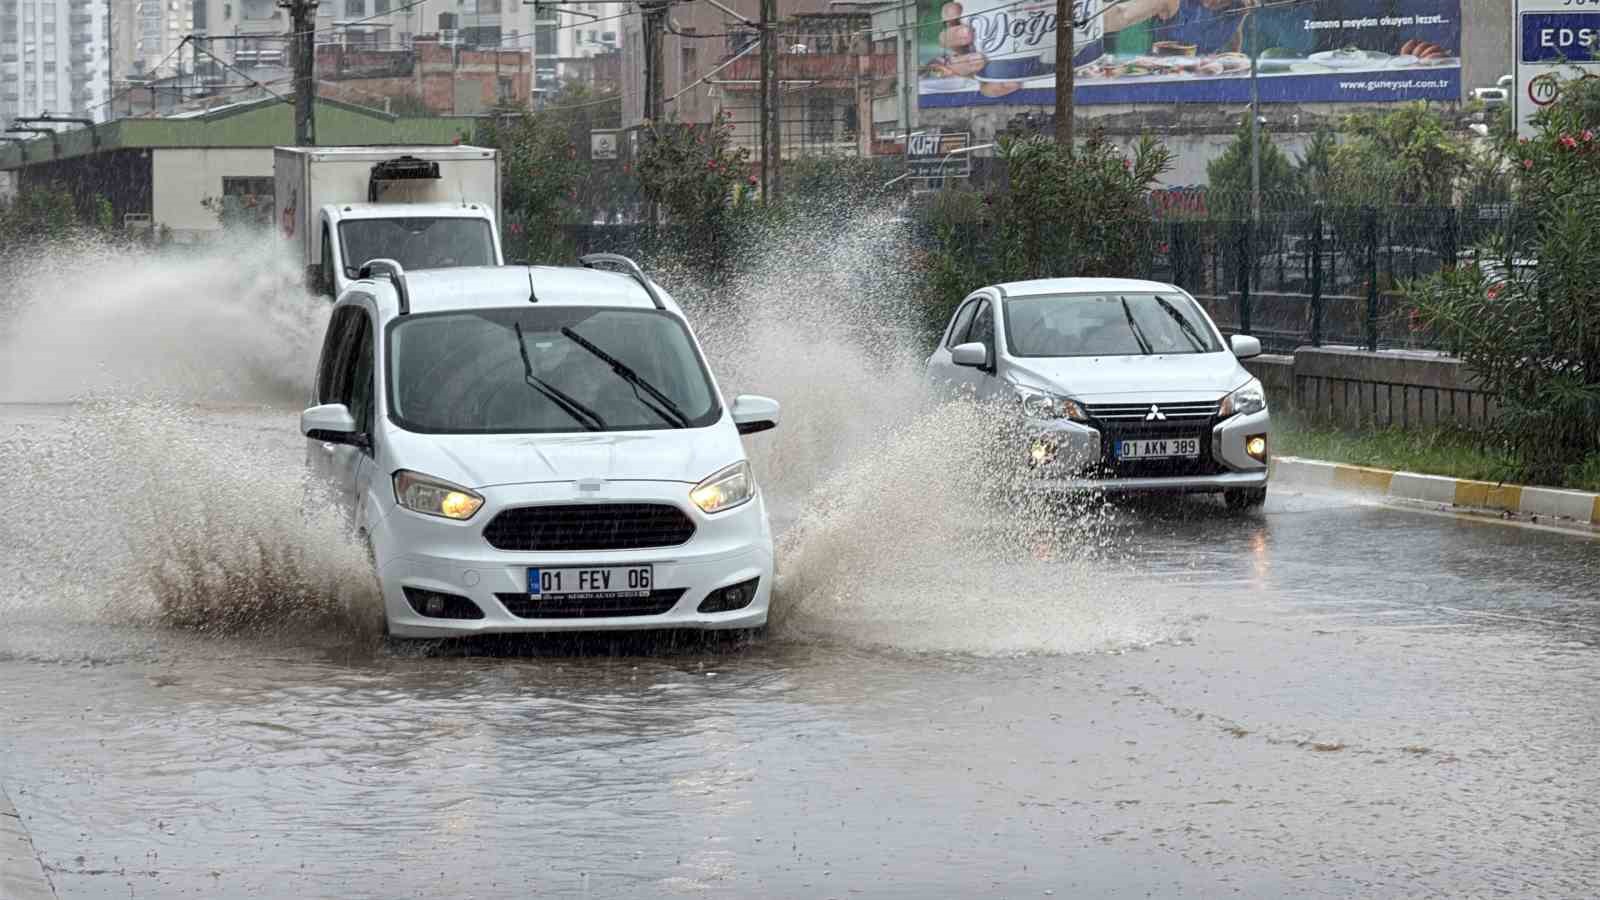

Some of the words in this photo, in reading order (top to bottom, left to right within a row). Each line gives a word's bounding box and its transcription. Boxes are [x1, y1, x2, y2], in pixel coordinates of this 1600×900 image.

[968, 0, 1092, 53] Yoğut
[1303, 19, 1341, 30] Zamana
[1342, 17, 1378, 30] meydan
[1379, 15, 1414, 27] okuyan
[1339, 79, 1449, 92] www.guneysut.com.tr
[1536, 80, 1554, 98] 70
[907, 136, 940, 155] KURT
[1123, 443, 1137, 456] 01
[1144, 441, 1167, 455] AKN
[1173, 439, 1196, 454] 389
[541, 571, 562, 591] 01
[579, 570, 611, 590] FEV
[628, 568, 650, 589] 06
